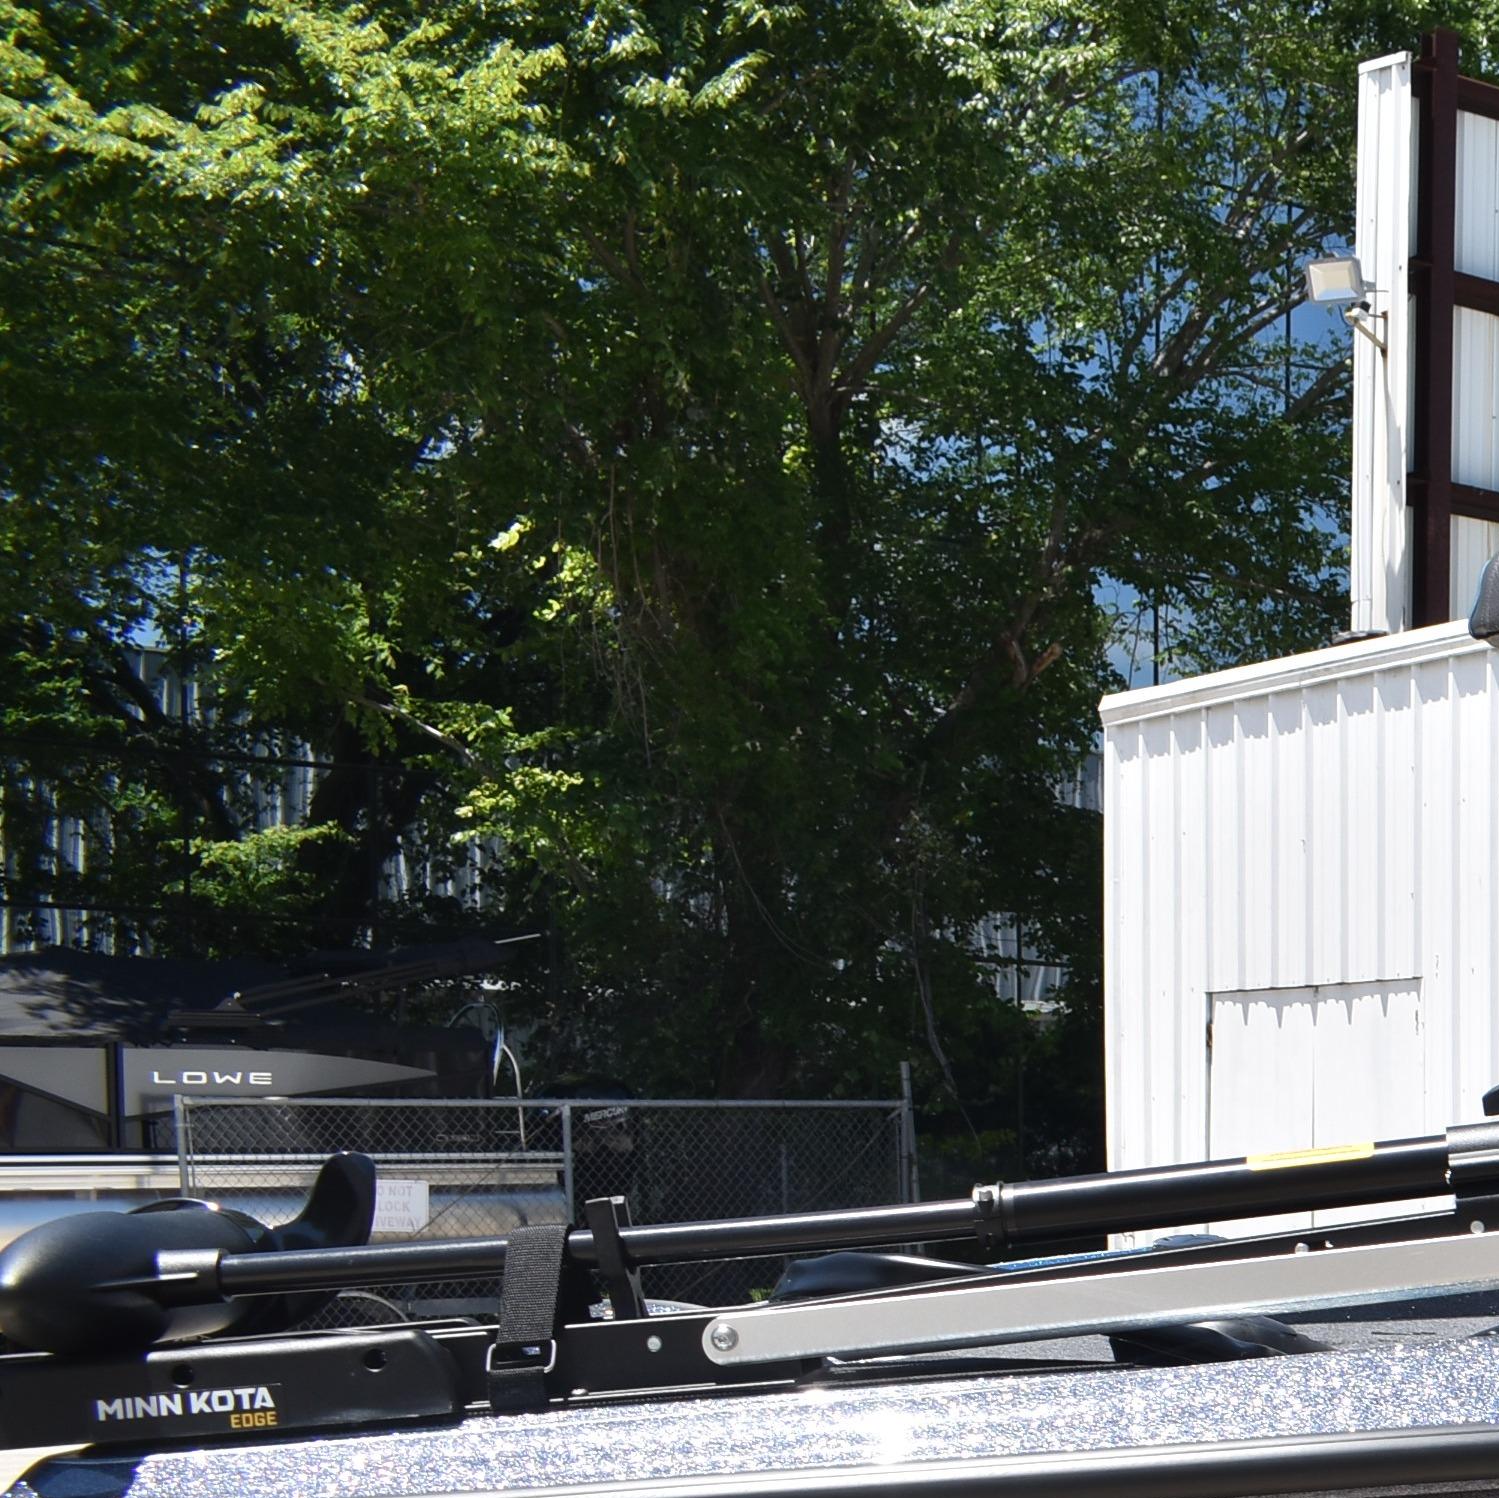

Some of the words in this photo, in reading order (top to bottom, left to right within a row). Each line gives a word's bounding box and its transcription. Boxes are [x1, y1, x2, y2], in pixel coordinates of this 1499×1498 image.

[153, 1071, 272, 1085] LOWE
[388, 1185, 413, 1197] NOT
[378, 1200, 411, 1213] LOCK
[376, 1215, 422, 1228] IVEWAY
[97, 1393, 183, 1421] MINN
[189, 1386, 276, 1414] KOTA
[229, 1411, 278, 1428] EDGE
